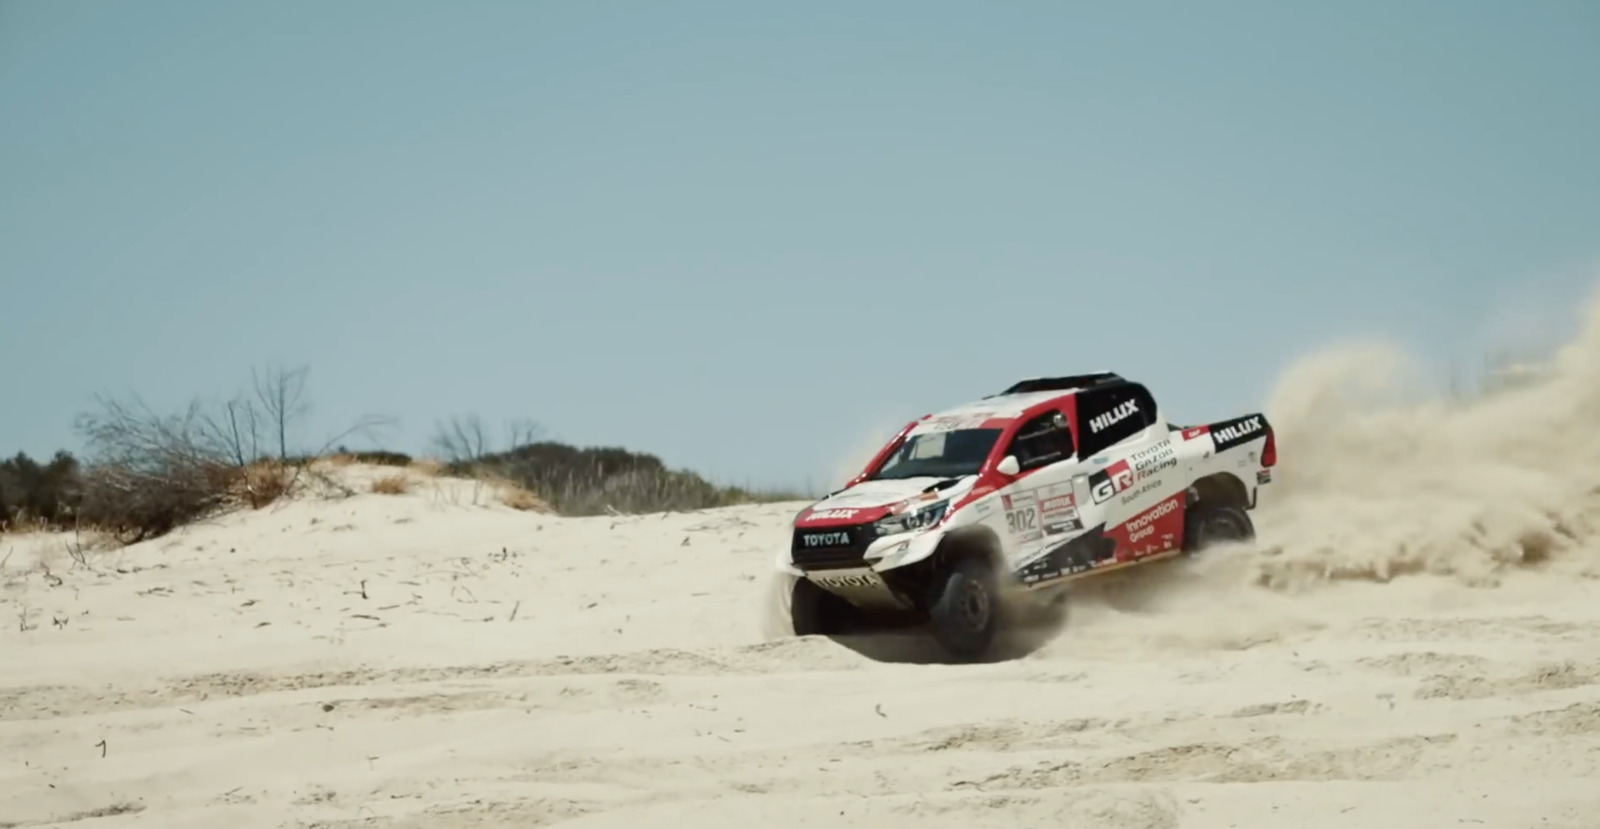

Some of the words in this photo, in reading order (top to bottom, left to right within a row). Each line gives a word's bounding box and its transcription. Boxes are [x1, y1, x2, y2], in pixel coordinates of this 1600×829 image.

[1089, 398, 1139, 433] HILUX
[1213, 416, 1262, 444] HILUX
[1130, 438, 1171, 461] TOYOTA
[1135, 448, 1174, 471] GAZOO
[1137, 457, 1178, 480] Racing
[1092, 468, 1134, 505] GR
[1006, 507, 1037, 534] 302
[1125, 499, 1179, 532] Innovation
[803, 532, 850, 547] TOYOTA
[1129, 524, 1155, 543] Group
[817, 575, 880, 589] TOYOTA
